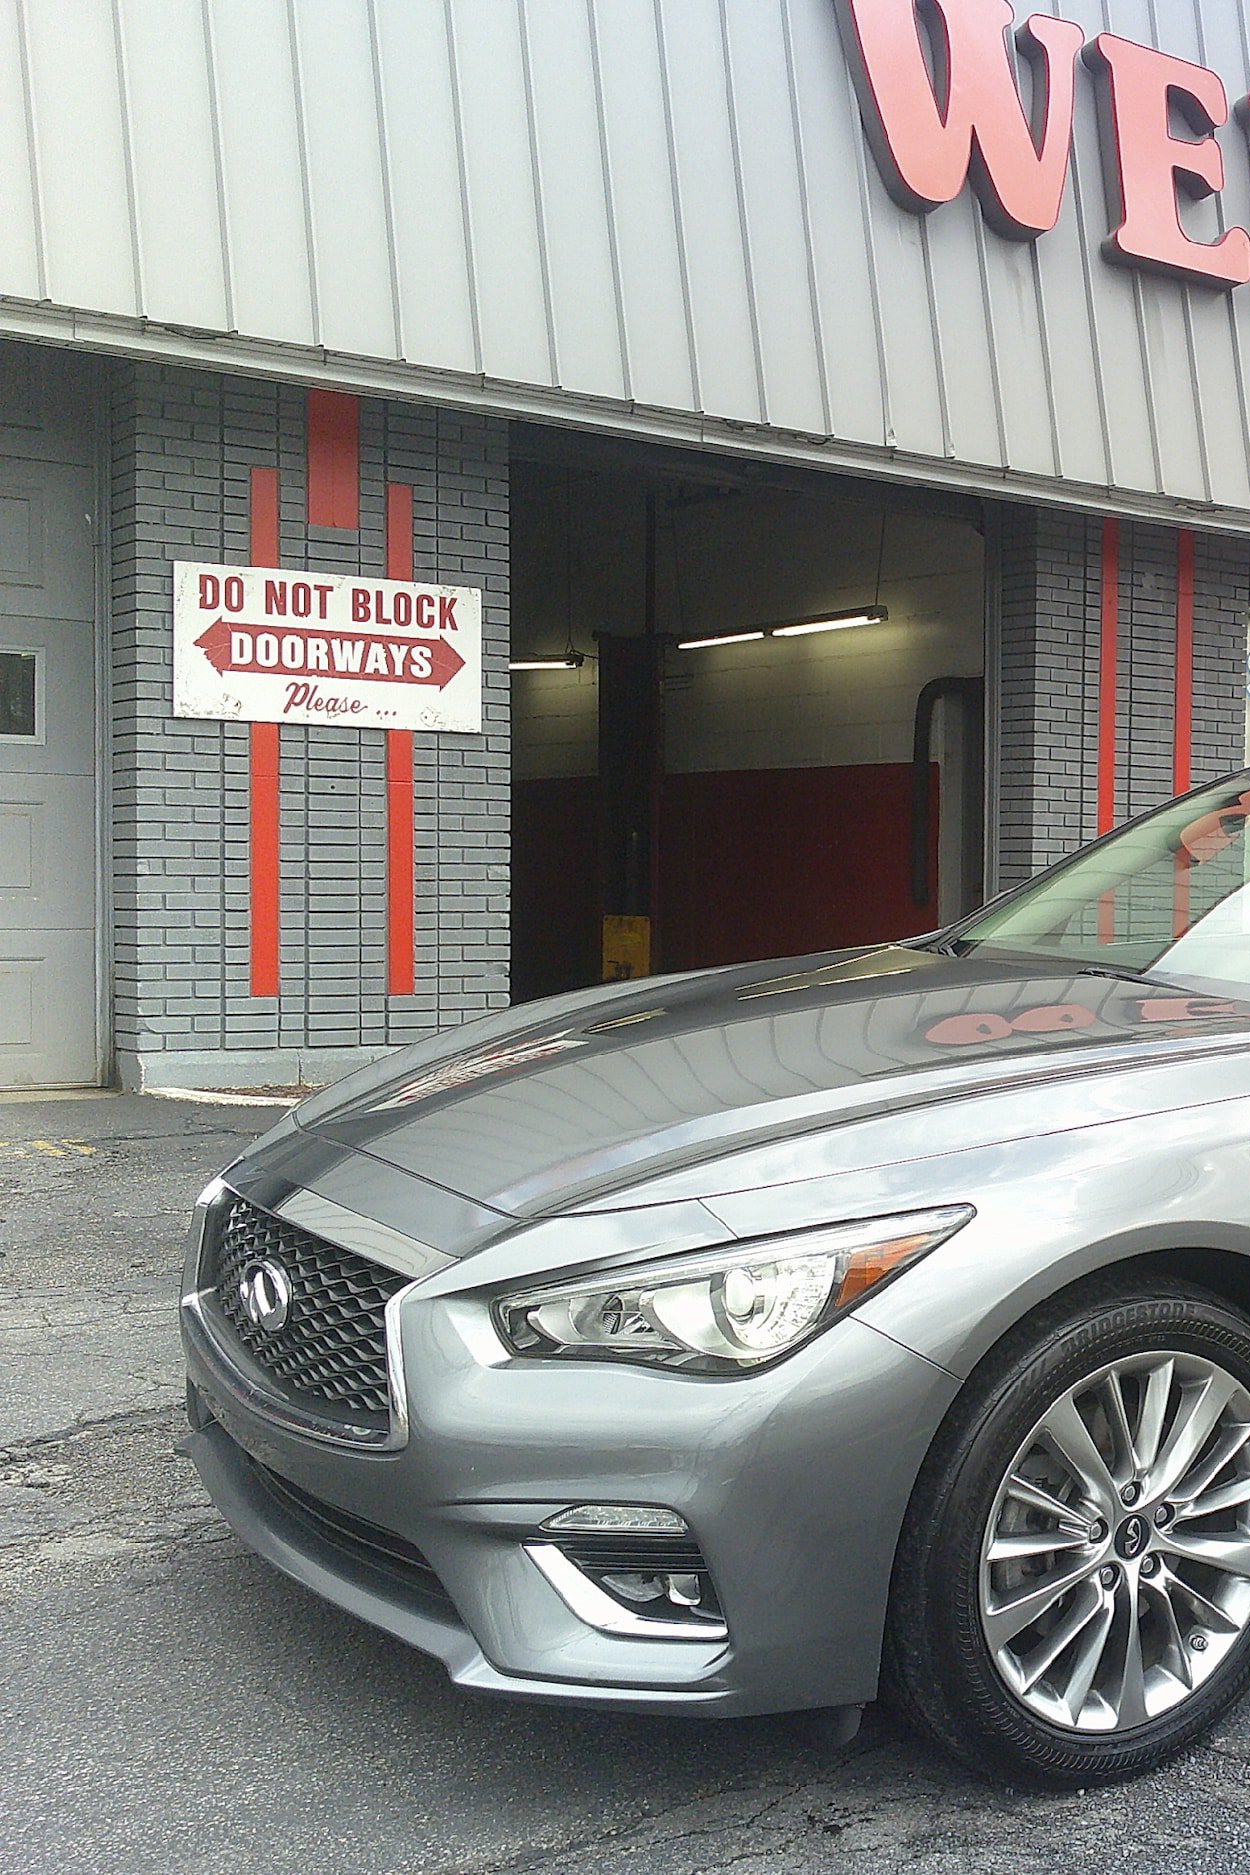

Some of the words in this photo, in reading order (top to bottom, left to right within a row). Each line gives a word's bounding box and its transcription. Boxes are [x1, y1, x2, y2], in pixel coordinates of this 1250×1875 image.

[199, 574, 244, 612] DO
[265, 580, 334, 619] NOT
[352, 588, 459, 631] BLOCK
[231, 631, 433, 679] DOORWAYS
